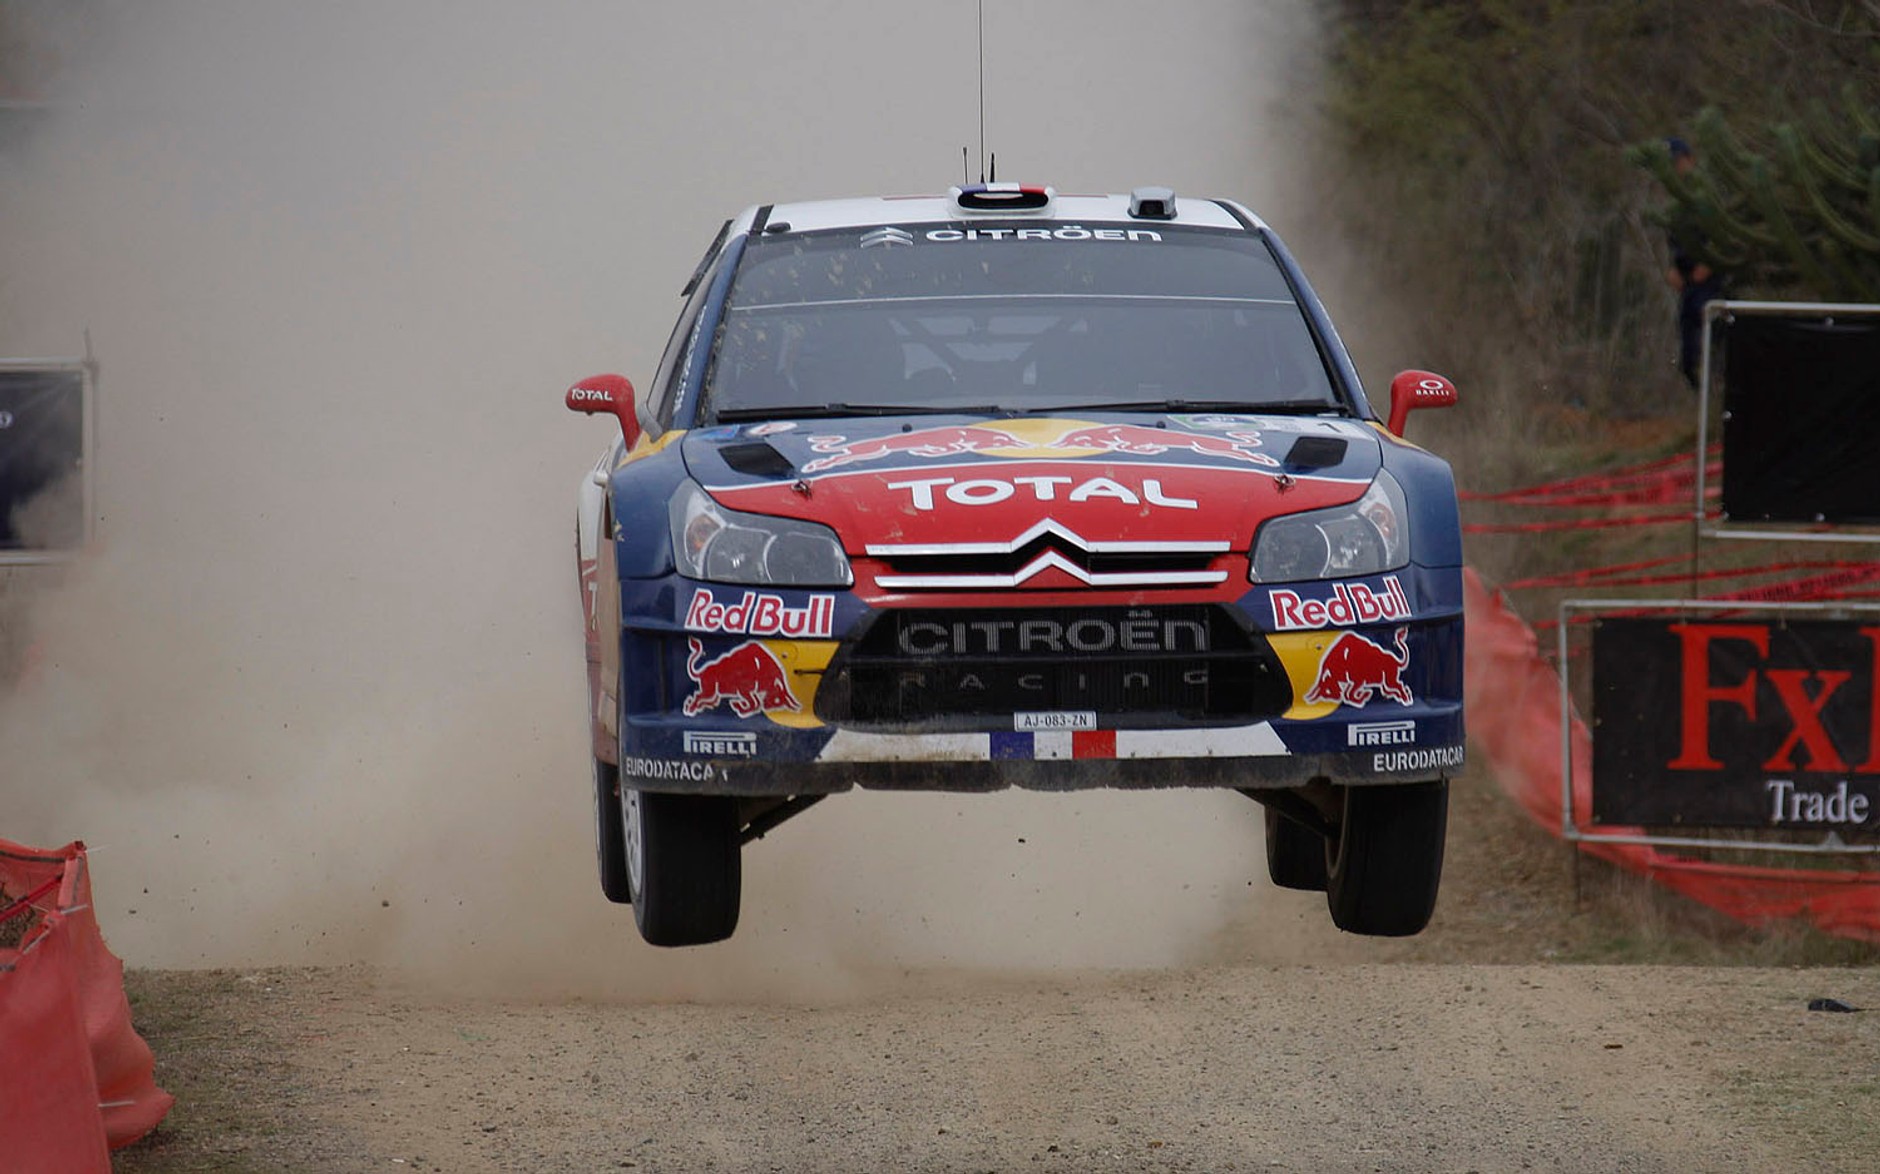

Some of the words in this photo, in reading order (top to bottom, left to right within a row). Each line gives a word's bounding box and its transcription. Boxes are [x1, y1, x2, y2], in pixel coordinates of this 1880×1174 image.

[571, 388, 613, 401] TOTAL
[888, 476, 1198, 510] TOTAL
[686, 590, 755, 632] Red
[751, 594, 834, 637] Bull
[1270, 583, 1355, 629] Red
[1348, 576, 1411, 623] Bull
[1024, 714, 1087, 727] AJ-083-ZN
[1347, 720, 1416, 746] PIRELLI
[683, 730, 757, 756] PIRELLI
[1767, 780, 1869, 823] Trade
